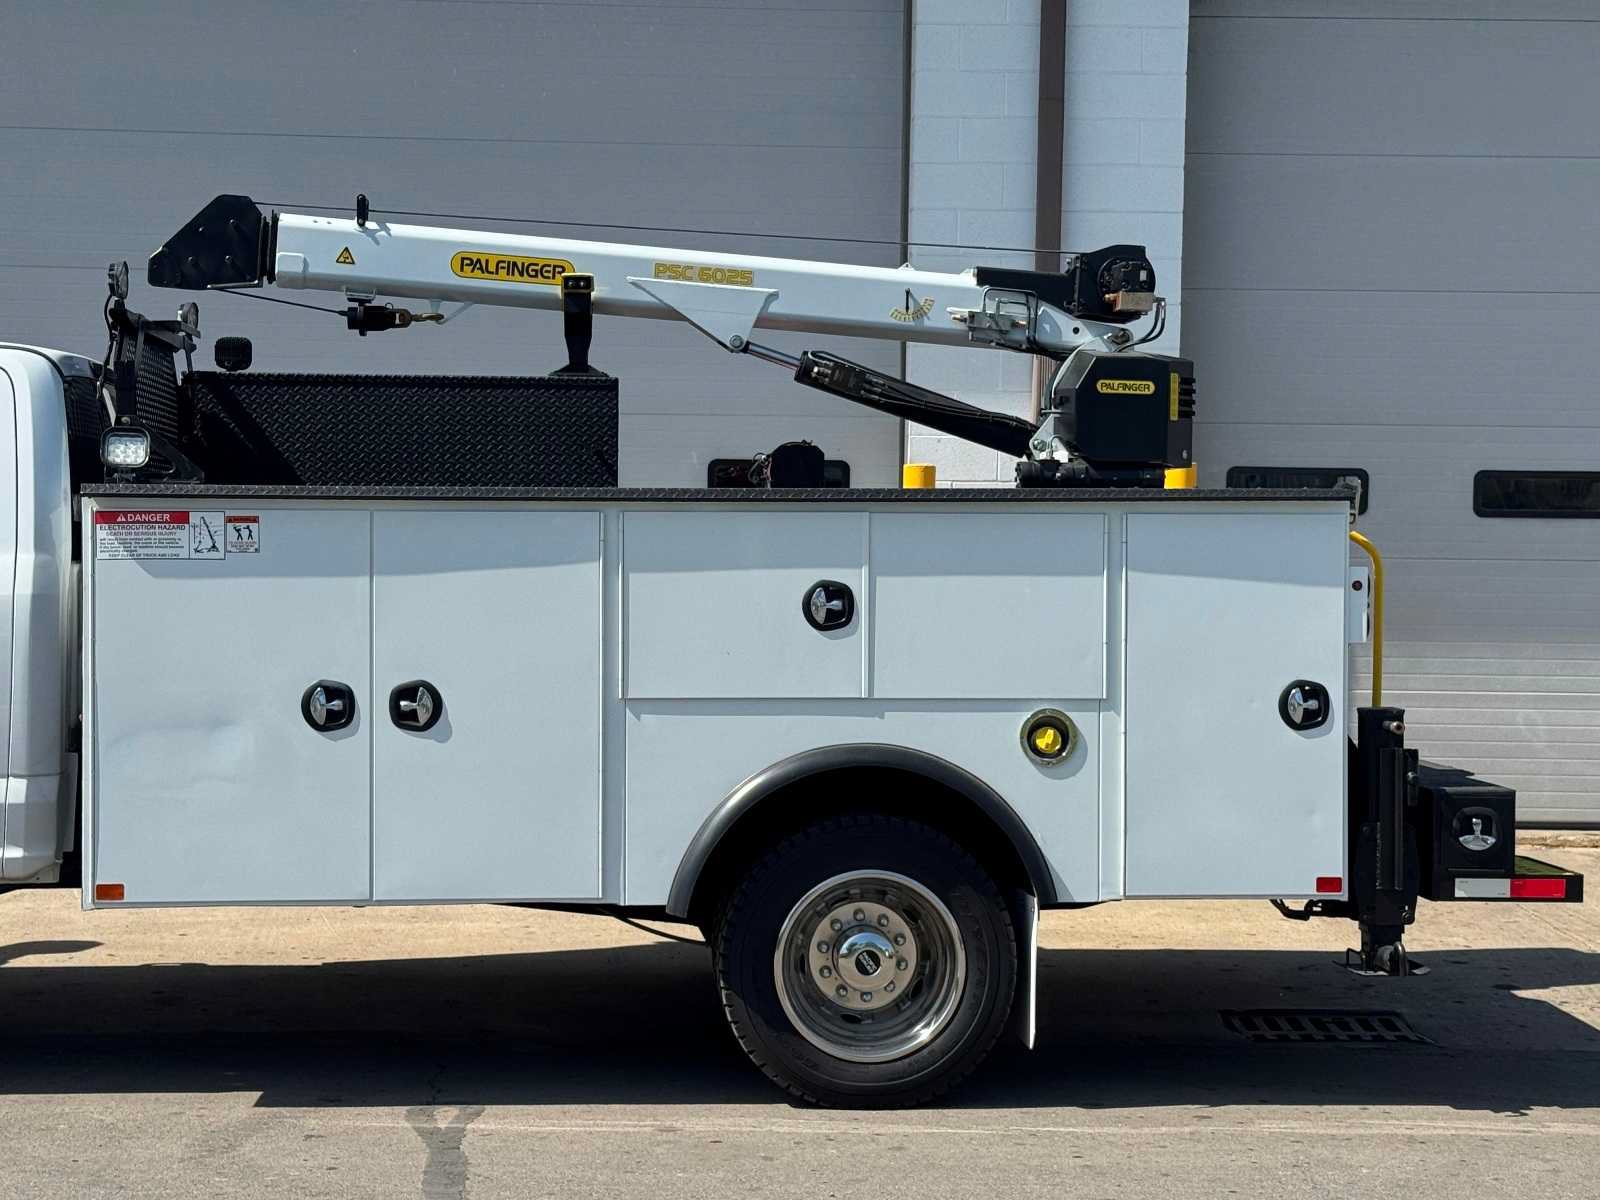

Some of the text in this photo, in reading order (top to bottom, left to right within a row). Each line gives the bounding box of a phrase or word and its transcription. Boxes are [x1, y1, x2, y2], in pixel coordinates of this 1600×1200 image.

[460, 257, 566, 280] PALFINGER
[655, 263, 753, 286] PSC 6025
[1100, 382, 1151, 392] PALFINGER
[127, 513, 171, 522] DANGER
